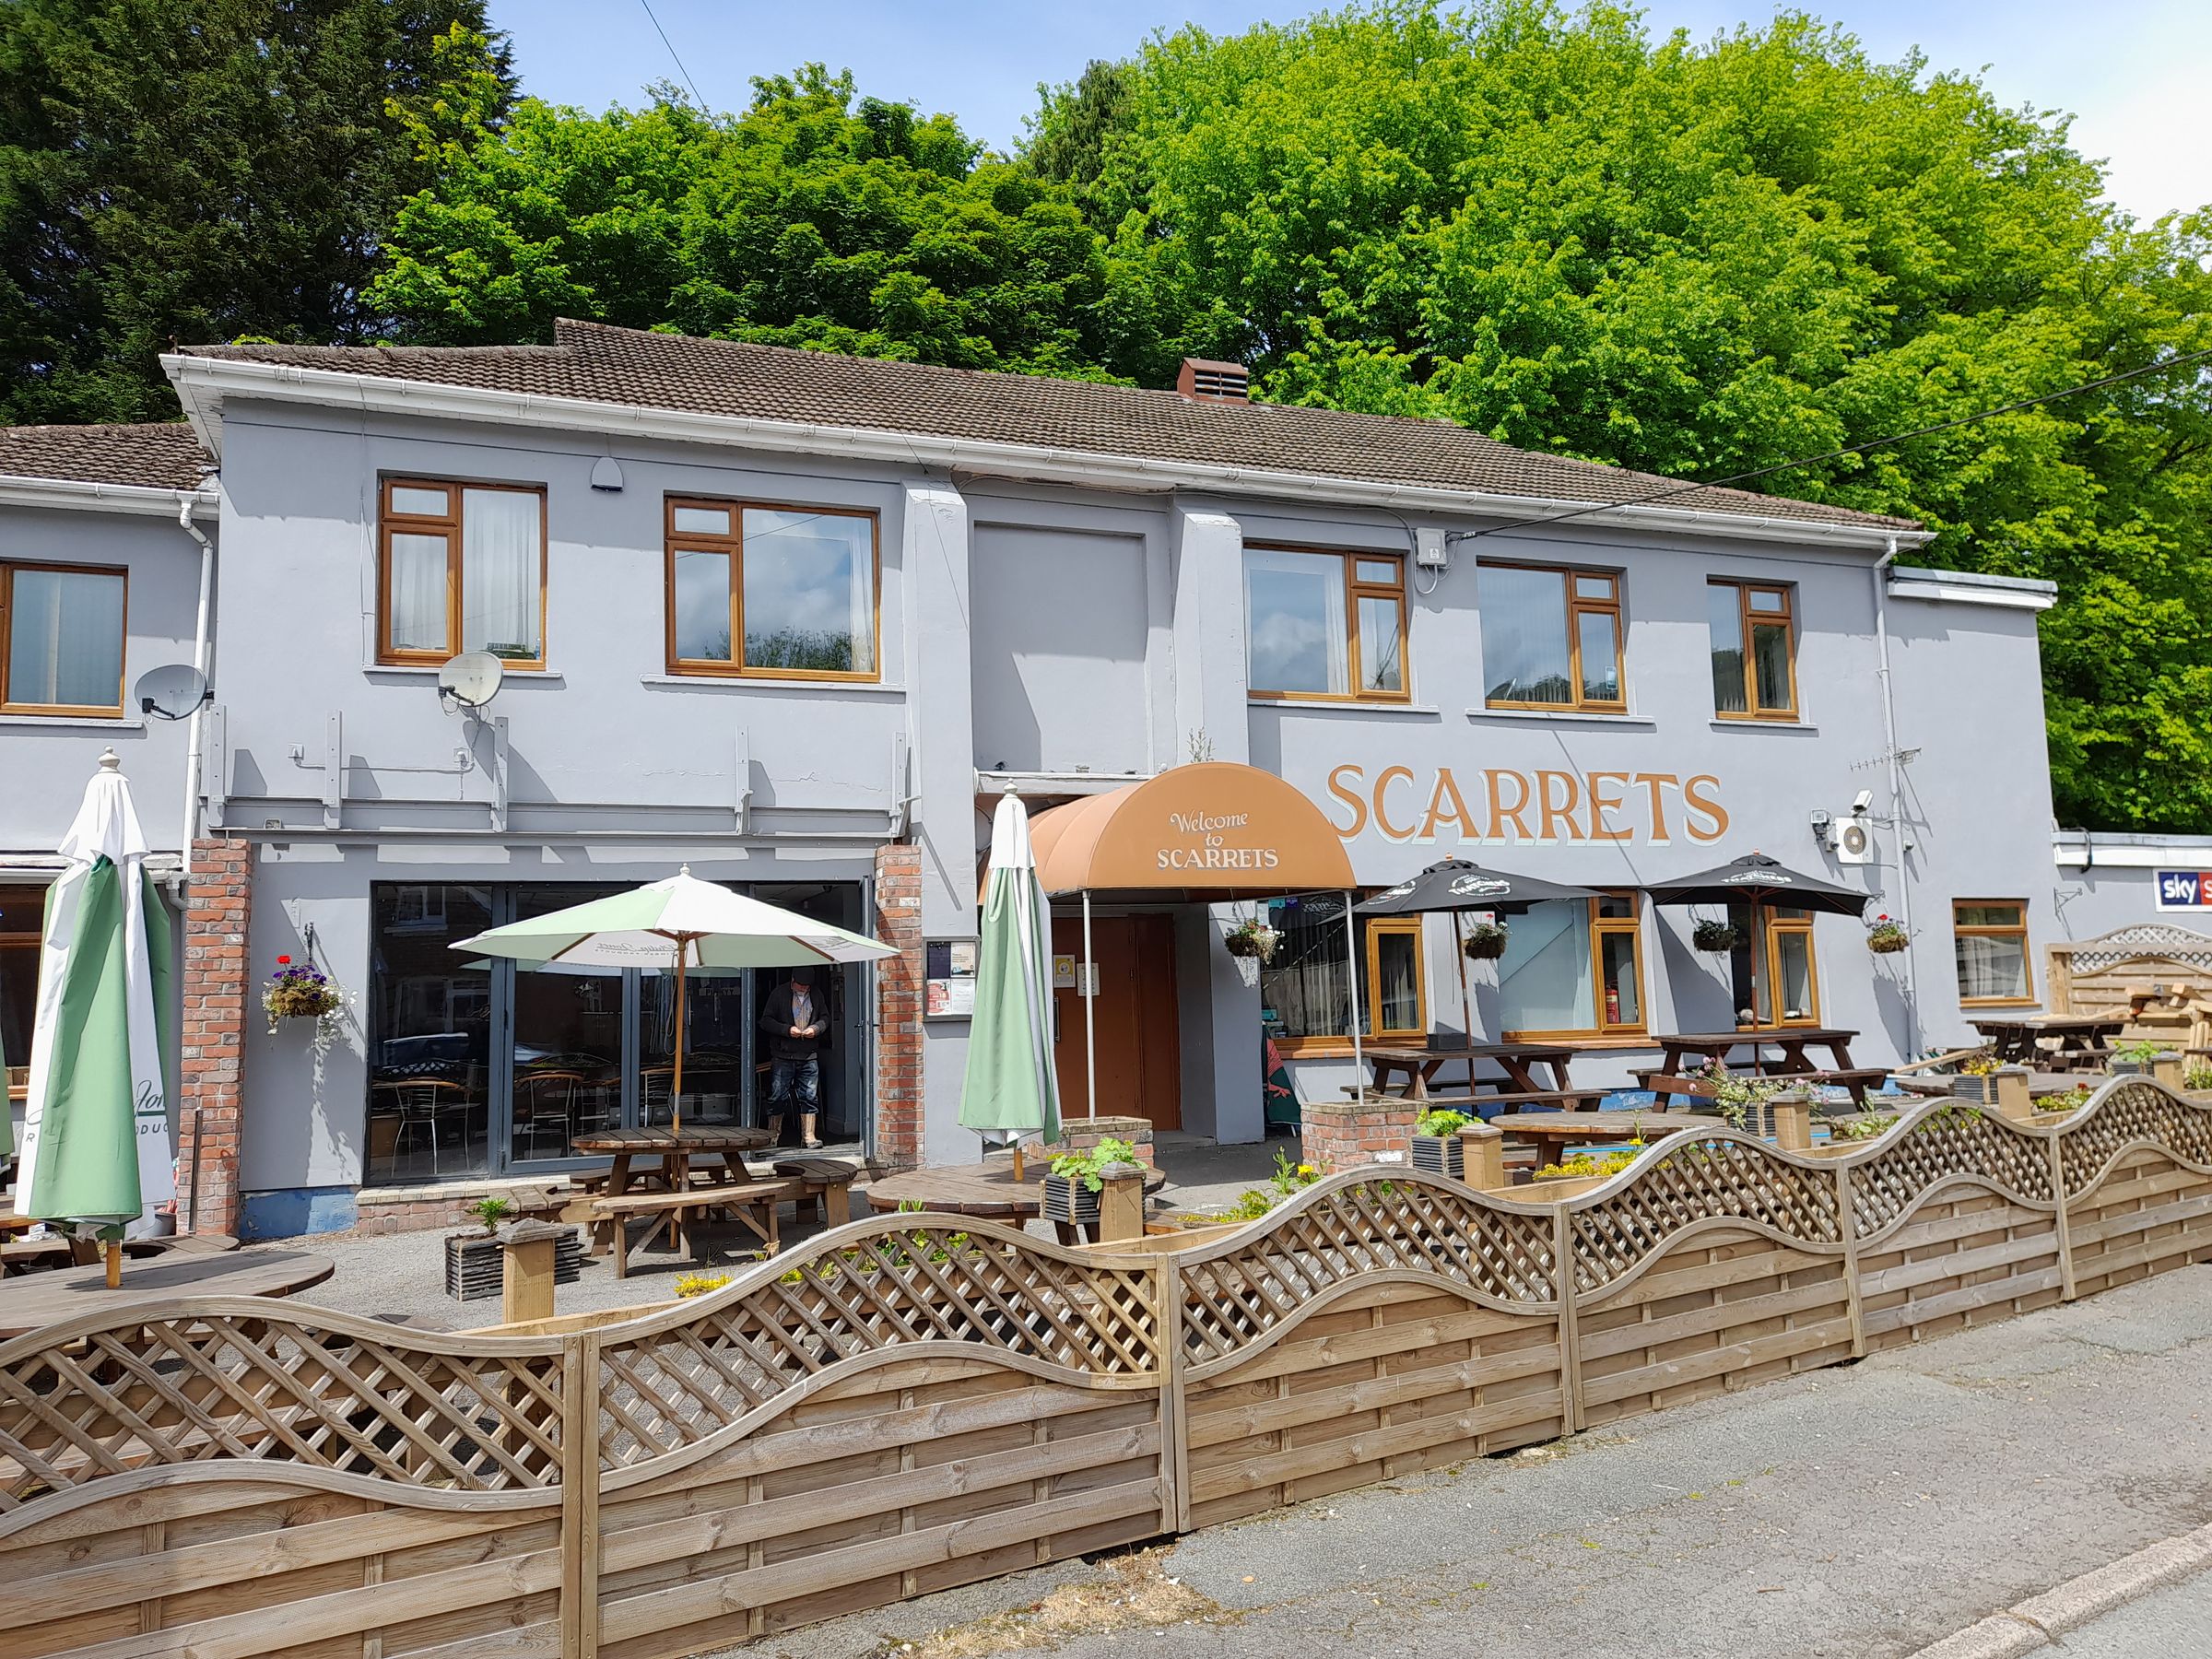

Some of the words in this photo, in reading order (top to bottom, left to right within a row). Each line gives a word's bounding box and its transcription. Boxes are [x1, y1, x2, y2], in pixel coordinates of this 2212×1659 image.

[1325, 763, 1731, 847] SCARRETS
[1170, 810, 1249, 833] Welcome
[1205, 832, 1225, 847] to
[1157, 848, 1280, 869] SCARRETS
[2163, 874, 2197, 904] sky
